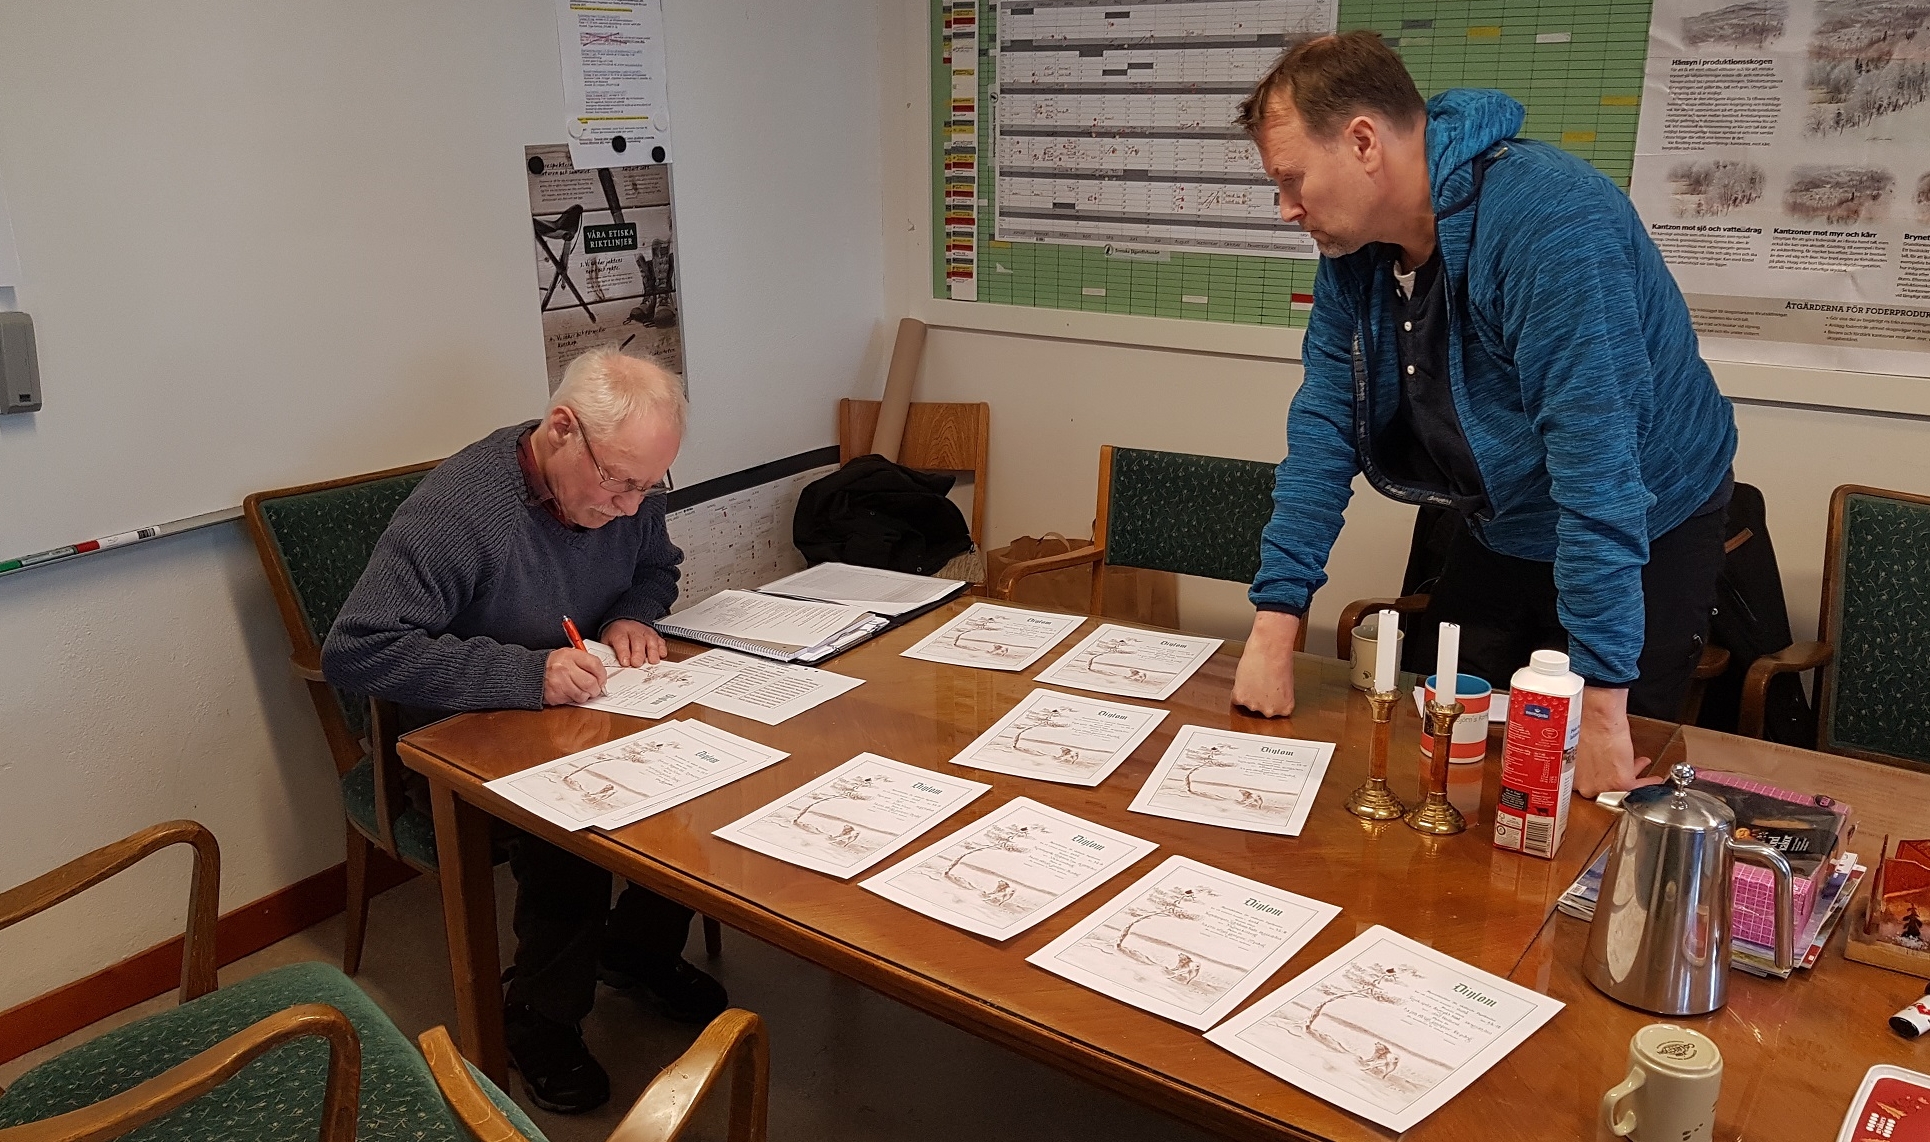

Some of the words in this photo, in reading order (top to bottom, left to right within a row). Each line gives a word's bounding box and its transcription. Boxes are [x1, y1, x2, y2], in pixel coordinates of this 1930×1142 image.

[1671, 59, 1698, 67] Hänsyn
[1701, 58, 1773, 67] produktionsskogen
[586, 229, 607, 239] VÅRA
[608, 228, 634, 238] ETISKA
[1651, 223, 1681, 231] Kantzon
[1722, 226, 1762, 235] vattedrag
[1773, 227, 1812, 236] Kantzoner
[1812, 229, 1828, 237] mot
[1828, 230, 1844, 239] myr
[589, 237, 634, 249] RIKTLINJER
[1784, 300, 1844, 313] ÅTGÄRDERNA
[1845, 304, 1864, 314] FÖR
[1026, 617, 1052, 626] Diplom
[1160, 639, 1187, 649] Diplom
[1097, 709, 1128, 721] Diplom
[694, 749, 720, 765] Diplom
[1260, 745, 1294, 758] Diplom
[911, 781, 943, 795] Diplom
[1071, 833, 1106, 851] Diplom
[1243, 896, 1284, 918] Diplom
[1451, 982, 1498, 1008] Diplom
